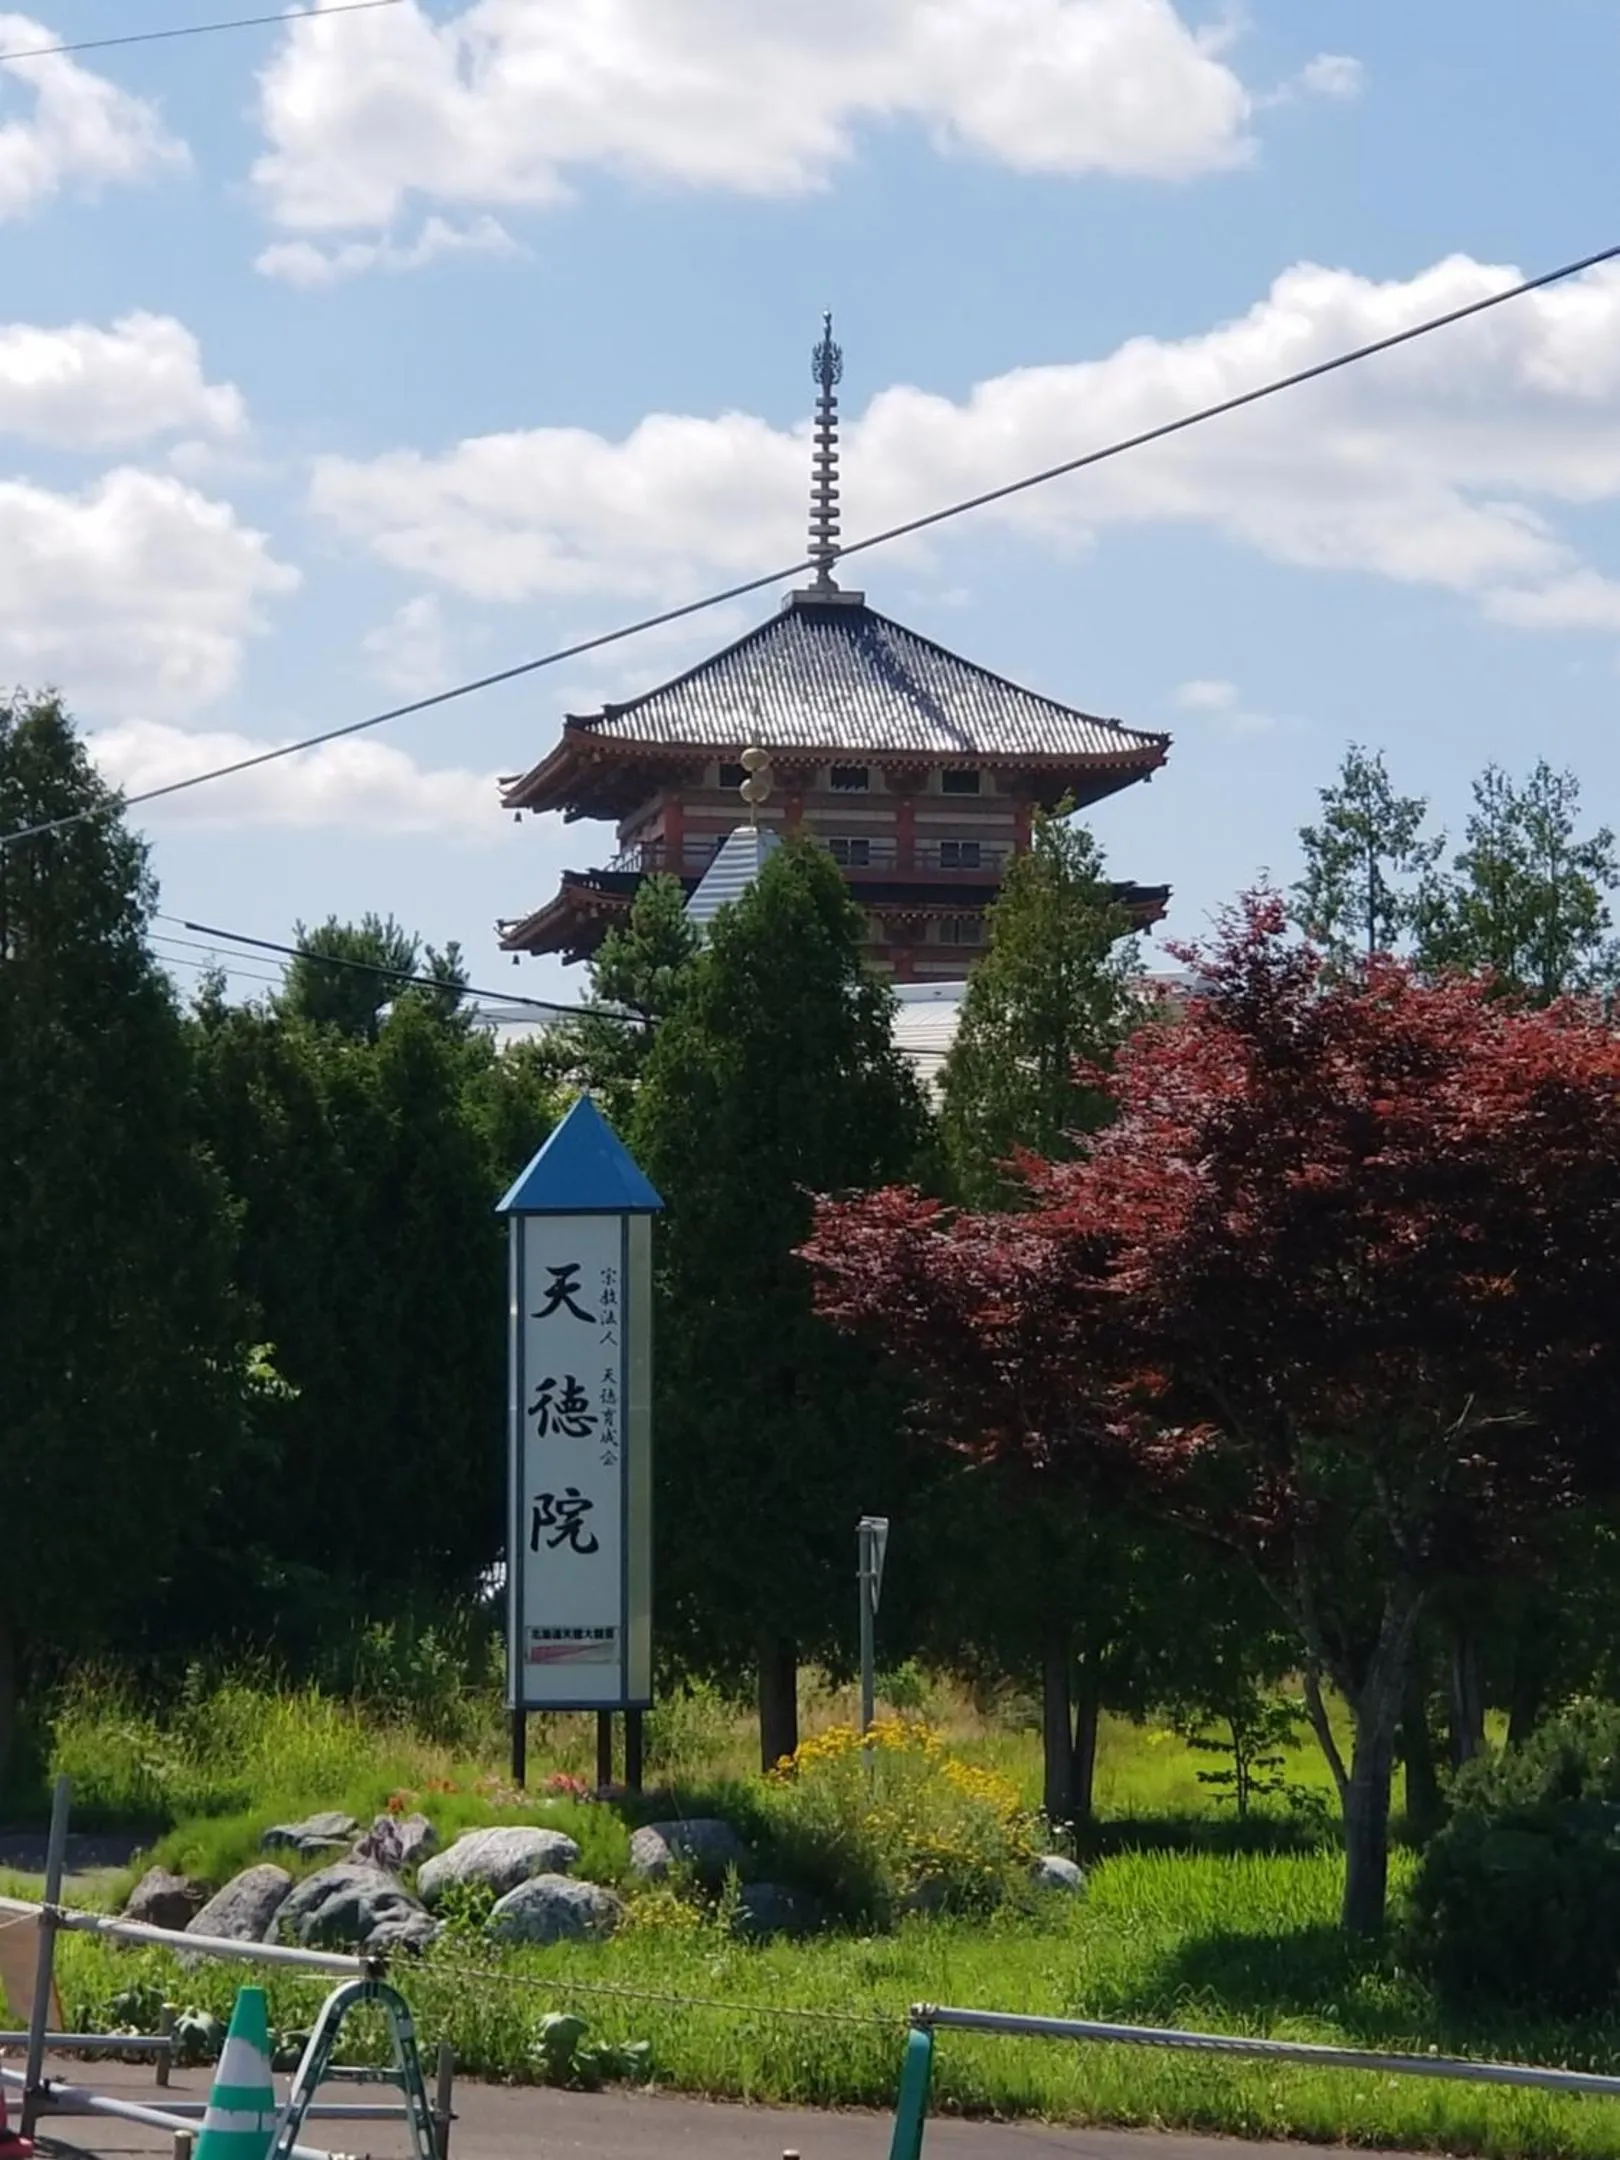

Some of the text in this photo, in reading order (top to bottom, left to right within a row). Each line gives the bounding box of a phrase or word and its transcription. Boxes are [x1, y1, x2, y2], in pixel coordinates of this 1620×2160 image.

[600, 1267, 618, 1346] 宗教法人
[528, 1263, 599, 1555] 天徳院
